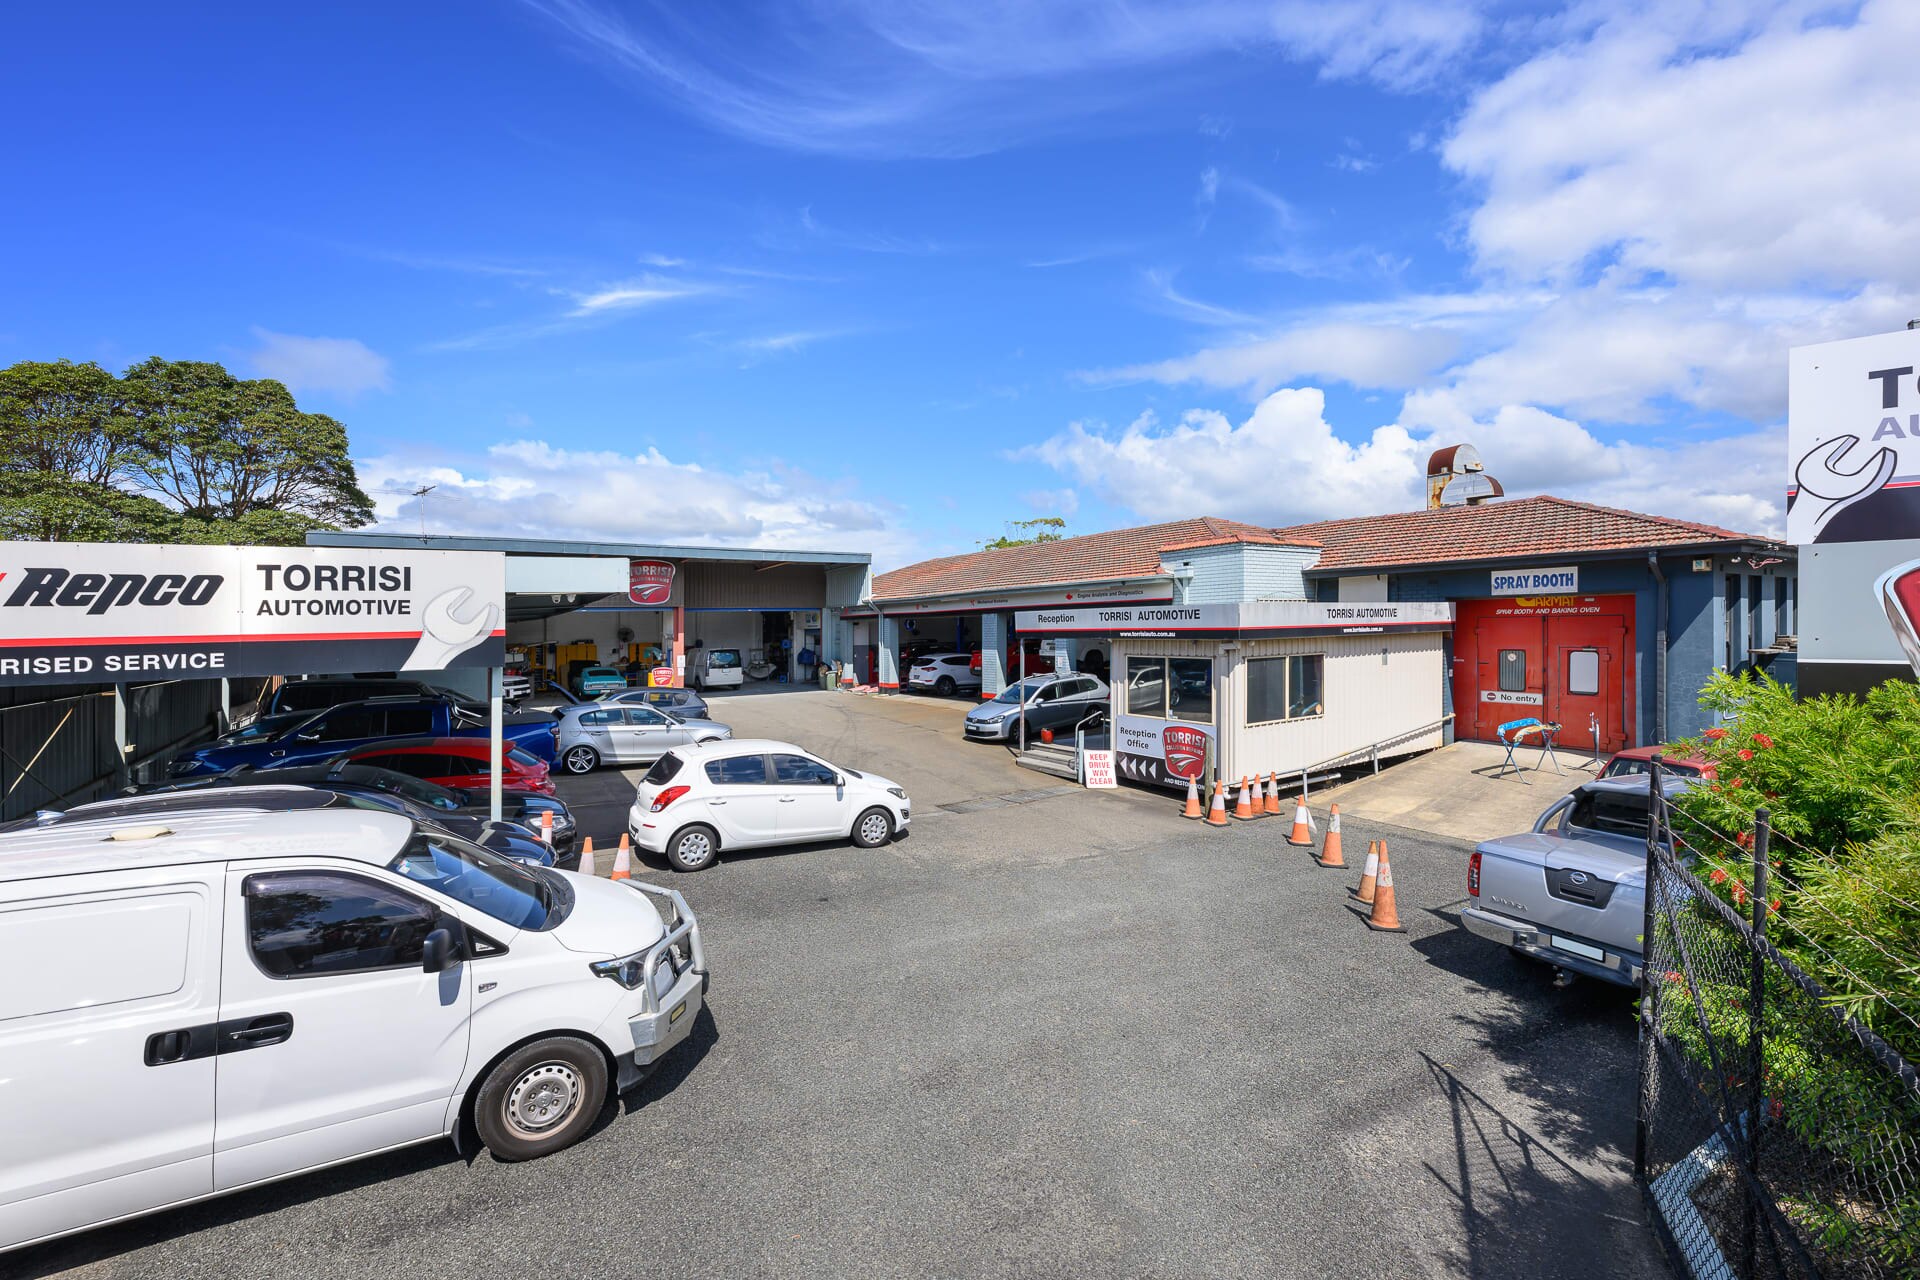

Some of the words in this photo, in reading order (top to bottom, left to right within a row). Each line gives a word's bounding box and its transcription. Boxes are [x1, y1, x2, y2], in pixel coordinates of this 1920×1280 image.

[1868, 366, 1920, 409] T
[256, 564, 411, 592] TORRISI
[1494, 575, 1530, 590] SPRAY
[1532, 572, 1574, 588] BOOTH
[3, 567, 225, 615] Repco
[256, 599, 411, 616] AUTOMOTIVE
[1327, 609, 1354, 618] TORRISI
[1356, 608, 1397, 618] AUTOMOTIVE
[1037, 614, 1075, 624] Reception
[1099, 611, 1132, 622] TORRISI
[1137, 609, 1200, 621] AUTOMOTIVE
[0, 656, 94, 675] RISED
[104, 652, 225, 671] SERVICE
[1120, 727, 1157, 739] Reception
[1165, 731, 1205, 748] TORRISI
[1127, 739, 1149, 749] Office
[1088, 761, 1111, 769] DRIVE
[1092, 769, 1109, 777] WAY
[1089, 777, 1113, 785] CLEAR
